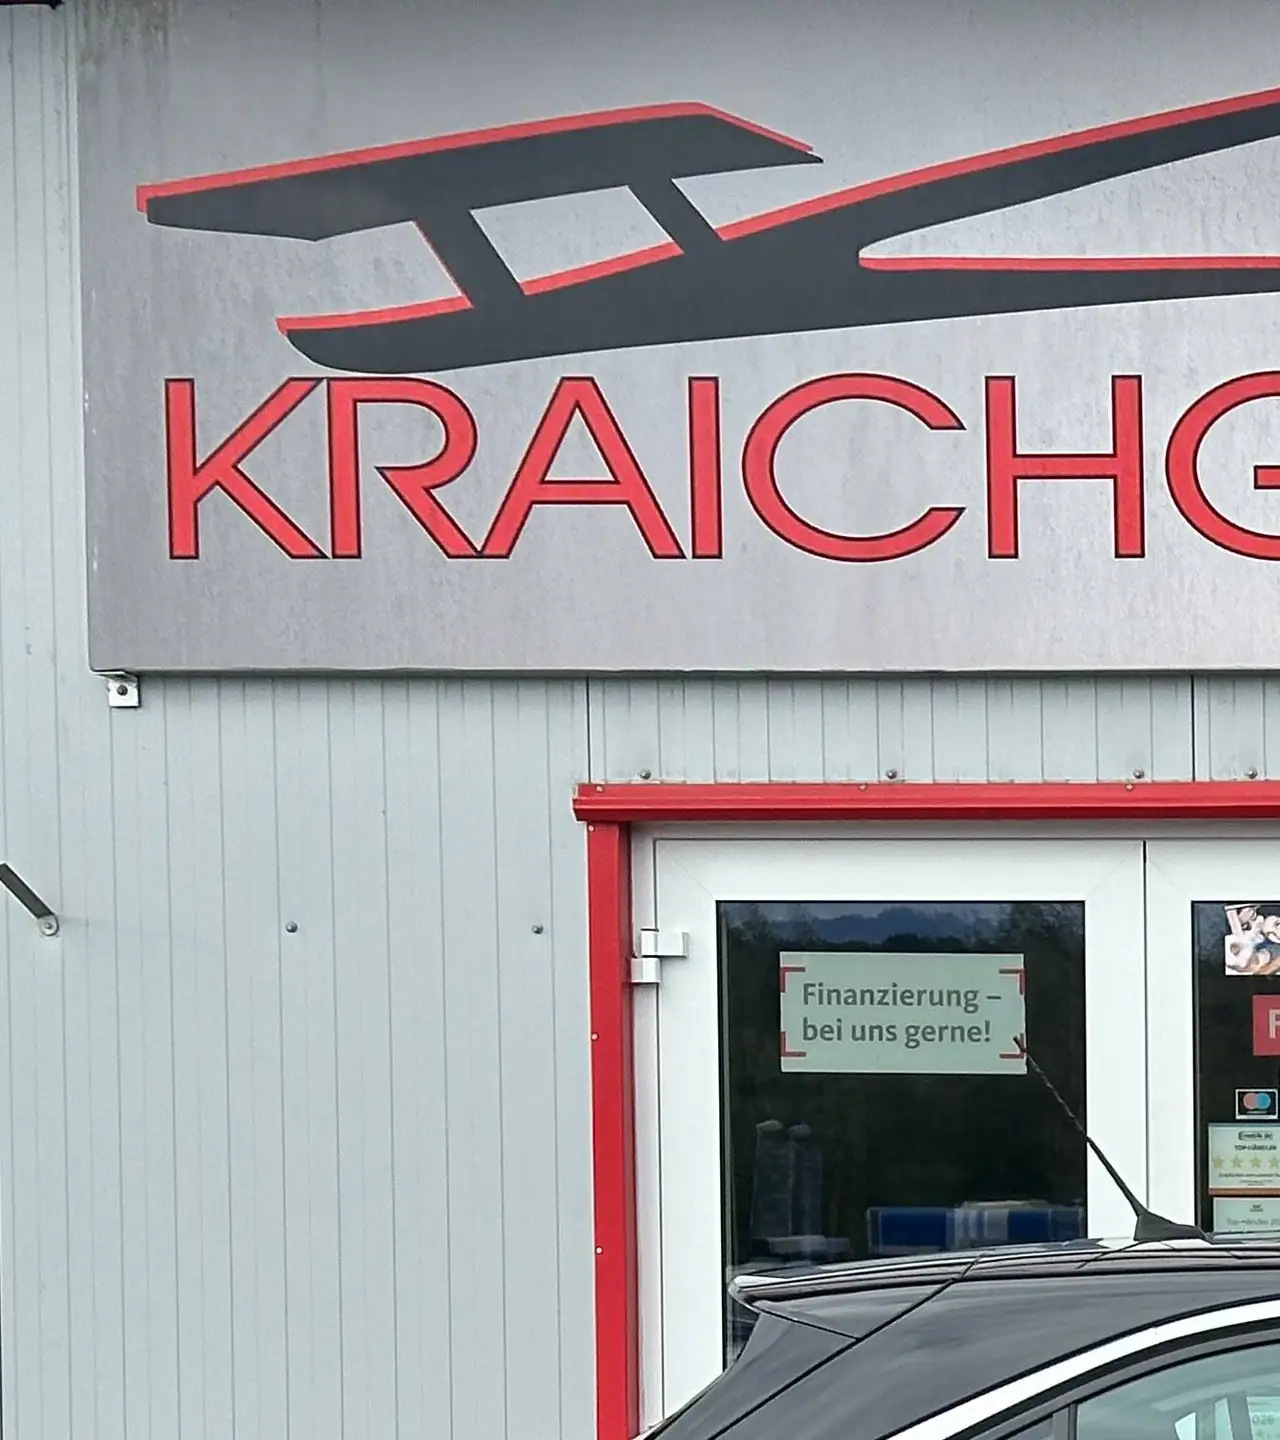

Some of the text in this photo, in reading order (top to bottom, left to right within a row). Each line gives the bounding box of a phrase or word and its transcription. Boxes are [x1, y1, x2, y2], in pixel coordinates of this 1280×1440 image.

[803, 982, 979, 1013] Finanzierung
[802, 1017, 991, 1049] bei uns gerne!
